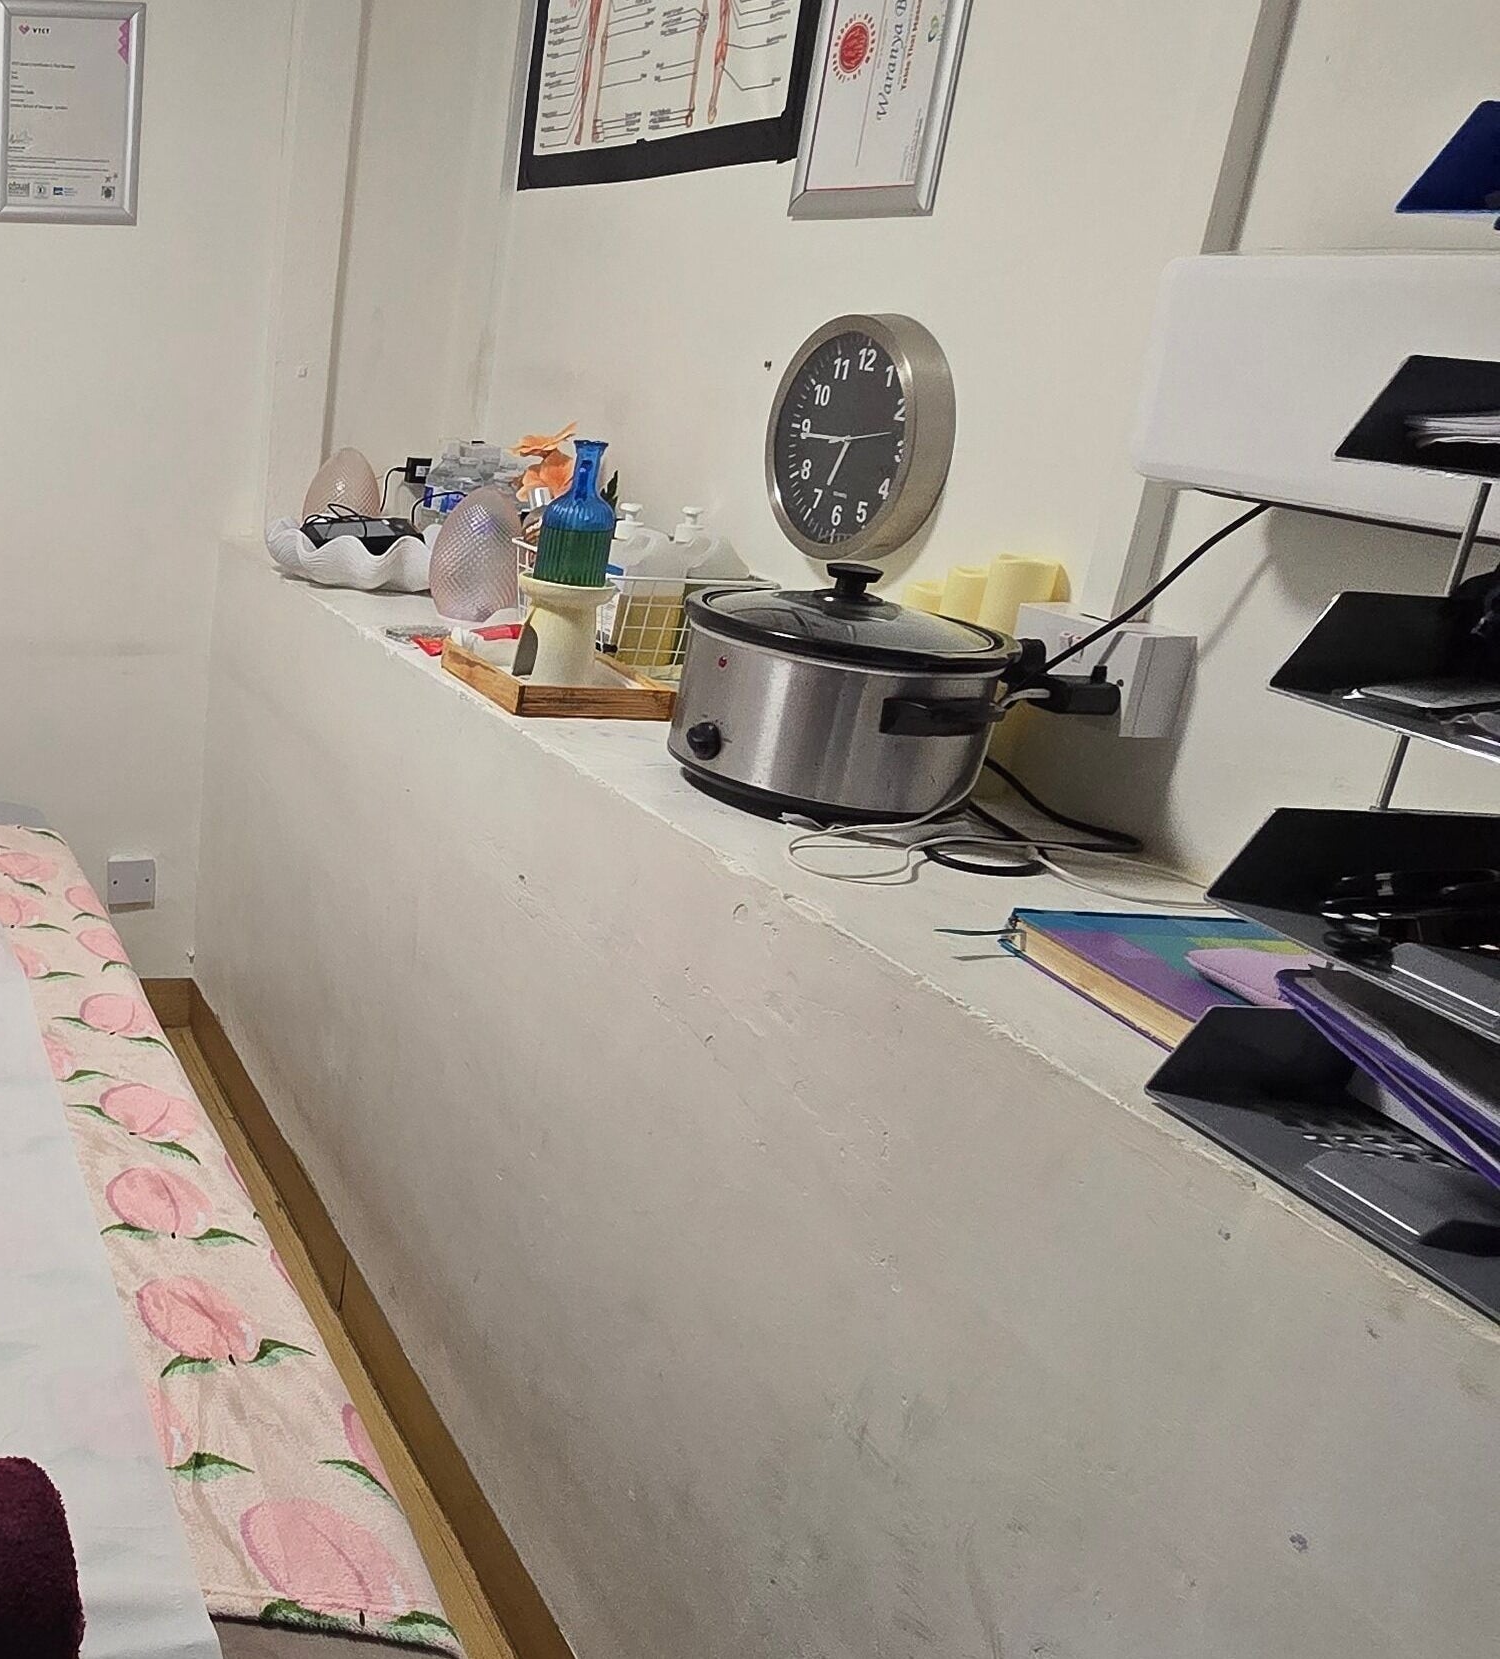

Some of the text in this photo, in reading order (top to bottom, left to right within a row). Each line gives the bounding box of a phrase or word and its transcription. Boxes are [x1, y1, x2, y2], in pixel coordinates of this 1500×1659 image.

[833, 358, 850, 380] 11
[858, 348, 877, 372] 12
[885, 365, 894, 387] 1
[814, 384, 831, 406] 10
[894, 398, 906, 421] 2
[801, 419, 811, 439] 9
[800, 459, 811, 480] 8
[813, 488, 823, 509] 7
[878, 477, 891, 500] 4
[831, 505, 842, 526] 6
[856, 501, 868, 523] 5
